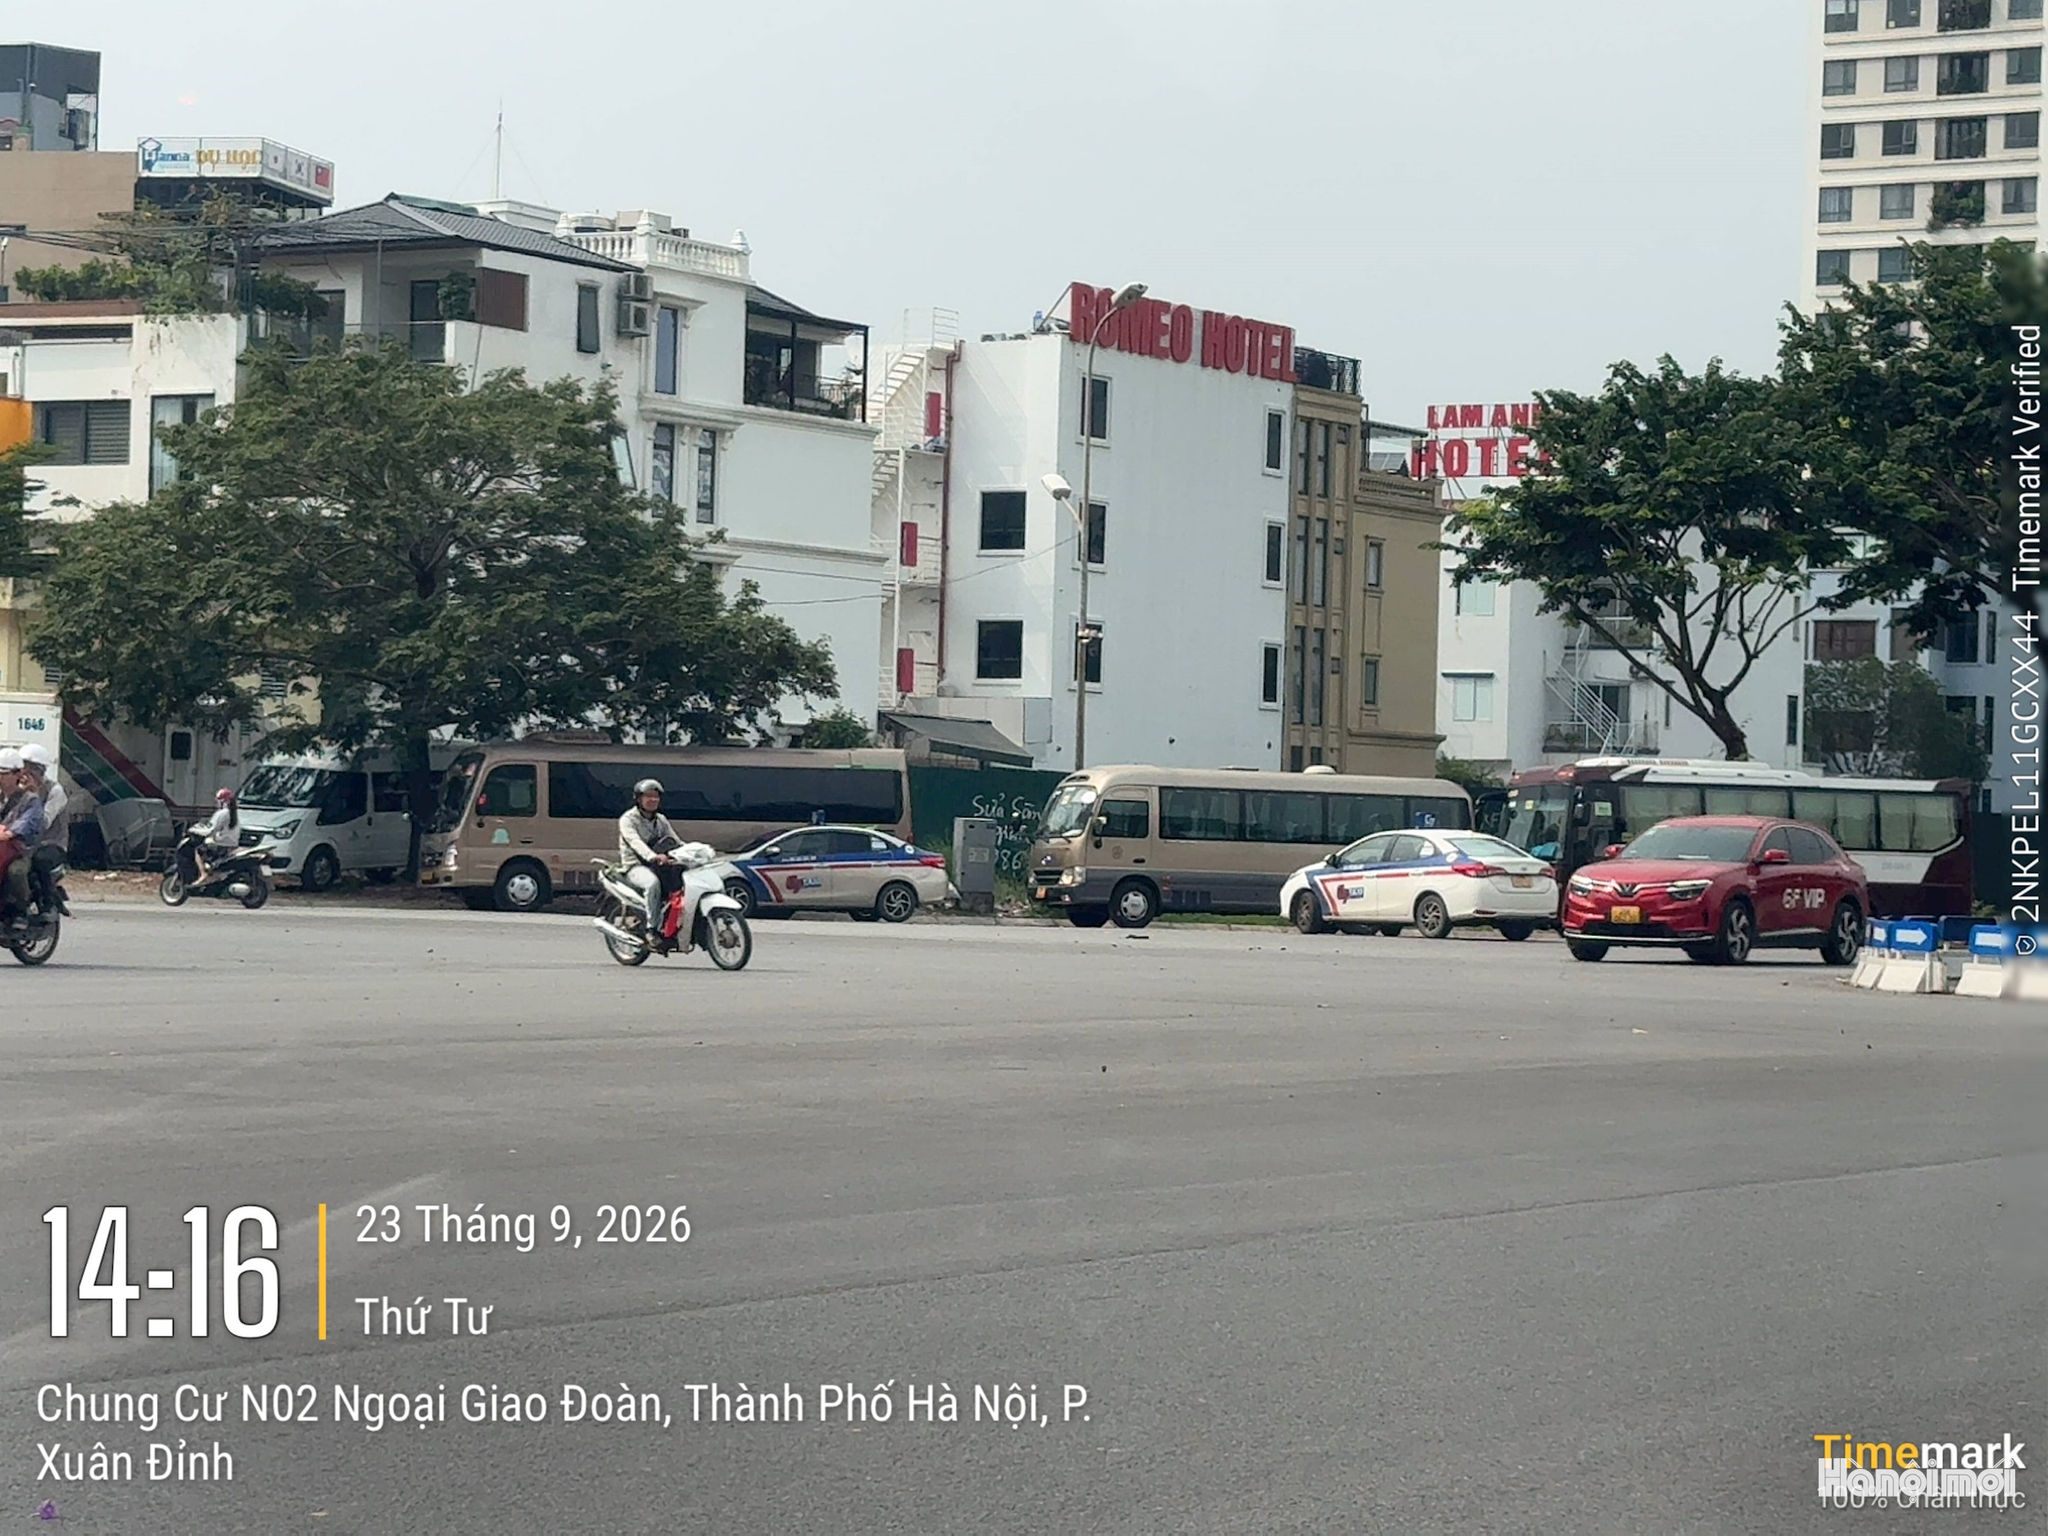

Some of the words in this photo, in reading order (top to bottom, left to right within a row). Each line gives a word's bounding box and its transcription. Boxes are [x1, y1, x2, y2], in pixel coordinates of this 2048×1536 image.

[1070, 282, 1193, 363] ROMEO
[1201, 310, 1298, 383] HOTEL
[1427, 405, 1483, 429] LAM
[1803, 888, 1826, 909] VIP
